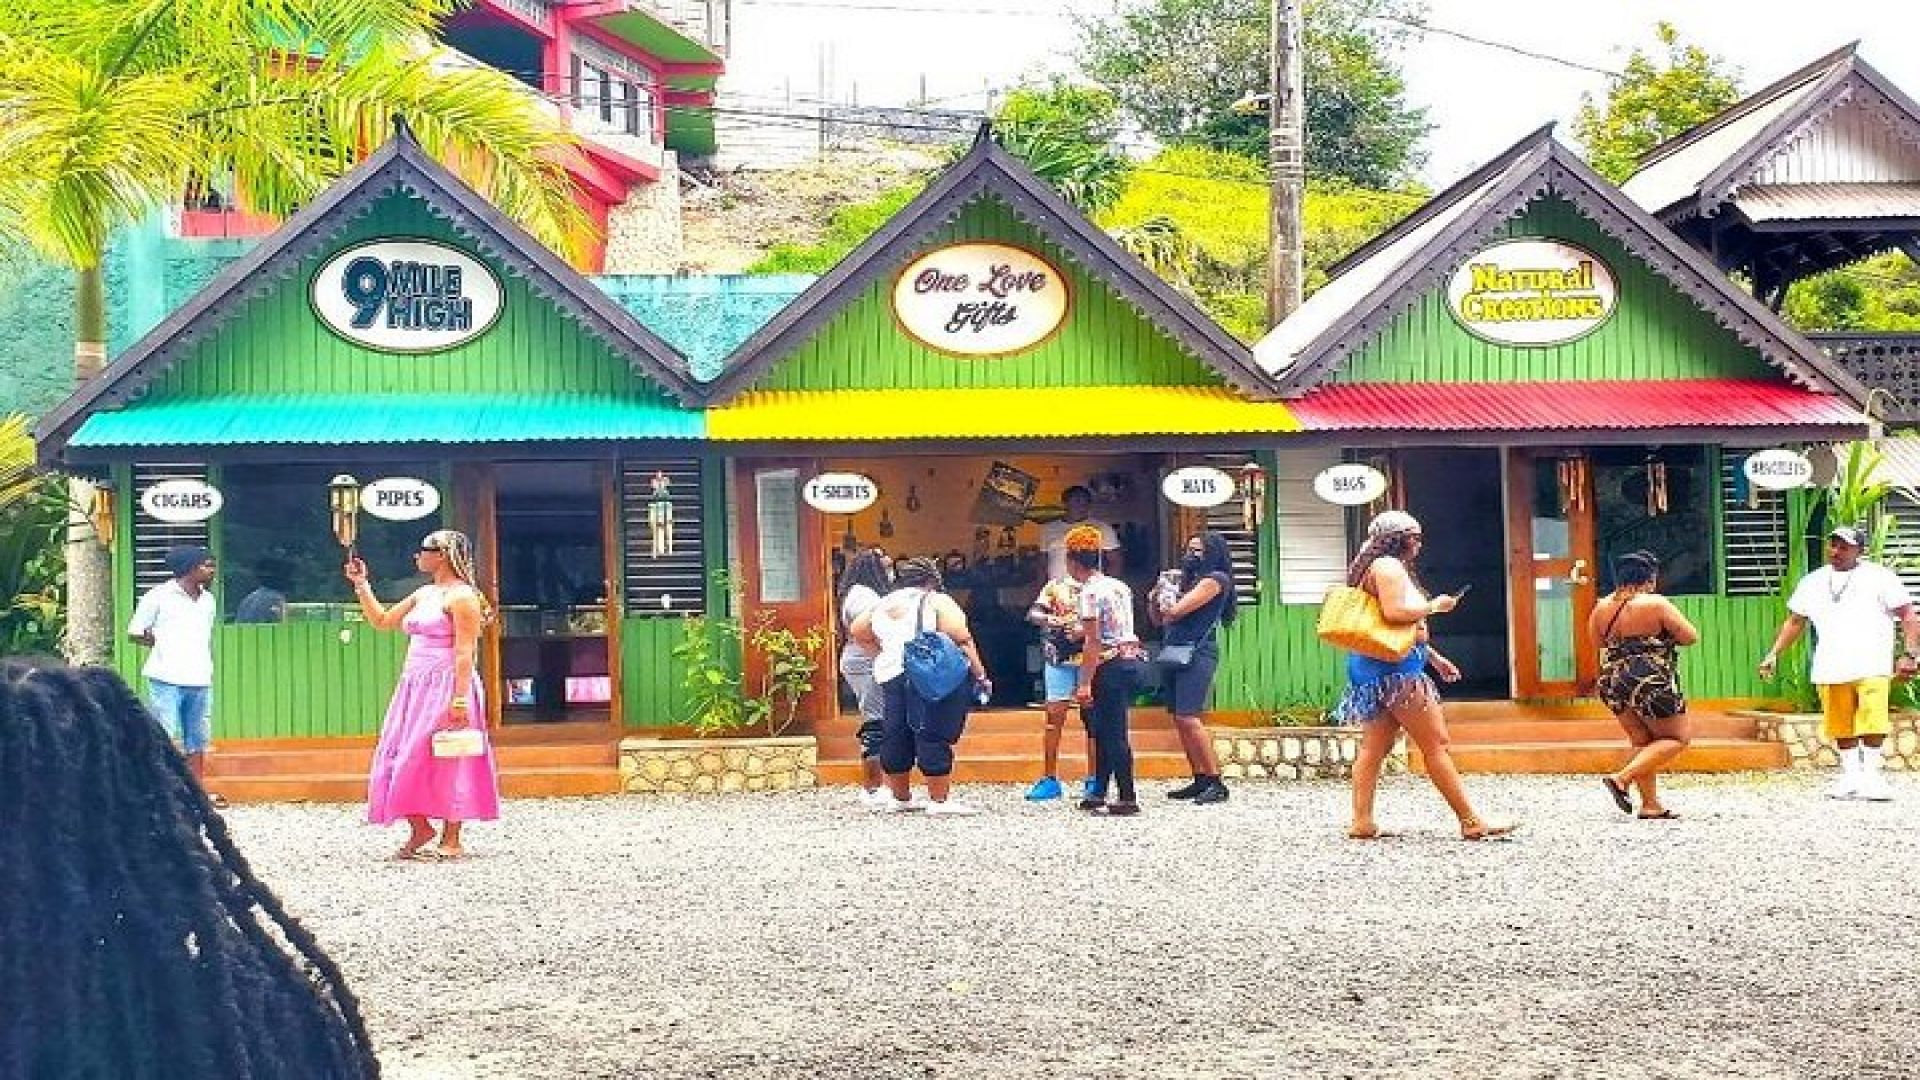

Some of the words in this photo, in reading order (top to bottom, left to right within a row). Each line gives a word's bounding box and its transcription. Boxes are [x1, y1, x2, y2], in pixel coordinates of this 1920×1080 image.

[914, 267, 970, 294] One
[977, 263, 1046, 299] Love
[341, 256, 388, 329] 9
[387, 260, 462, 298] MILE
[386, 296, 472, 331] HIGH
[943, 301, 1018, 333] Gifts
[1181, 479, 1217, 493] HATS
[1333, 476, 1366, 491] BAGS
[151, 492, 212, 508] CIGARS
[375, 490, 425, 506] PIPES
[811, 485, 870, 499] T-SHIRTS
